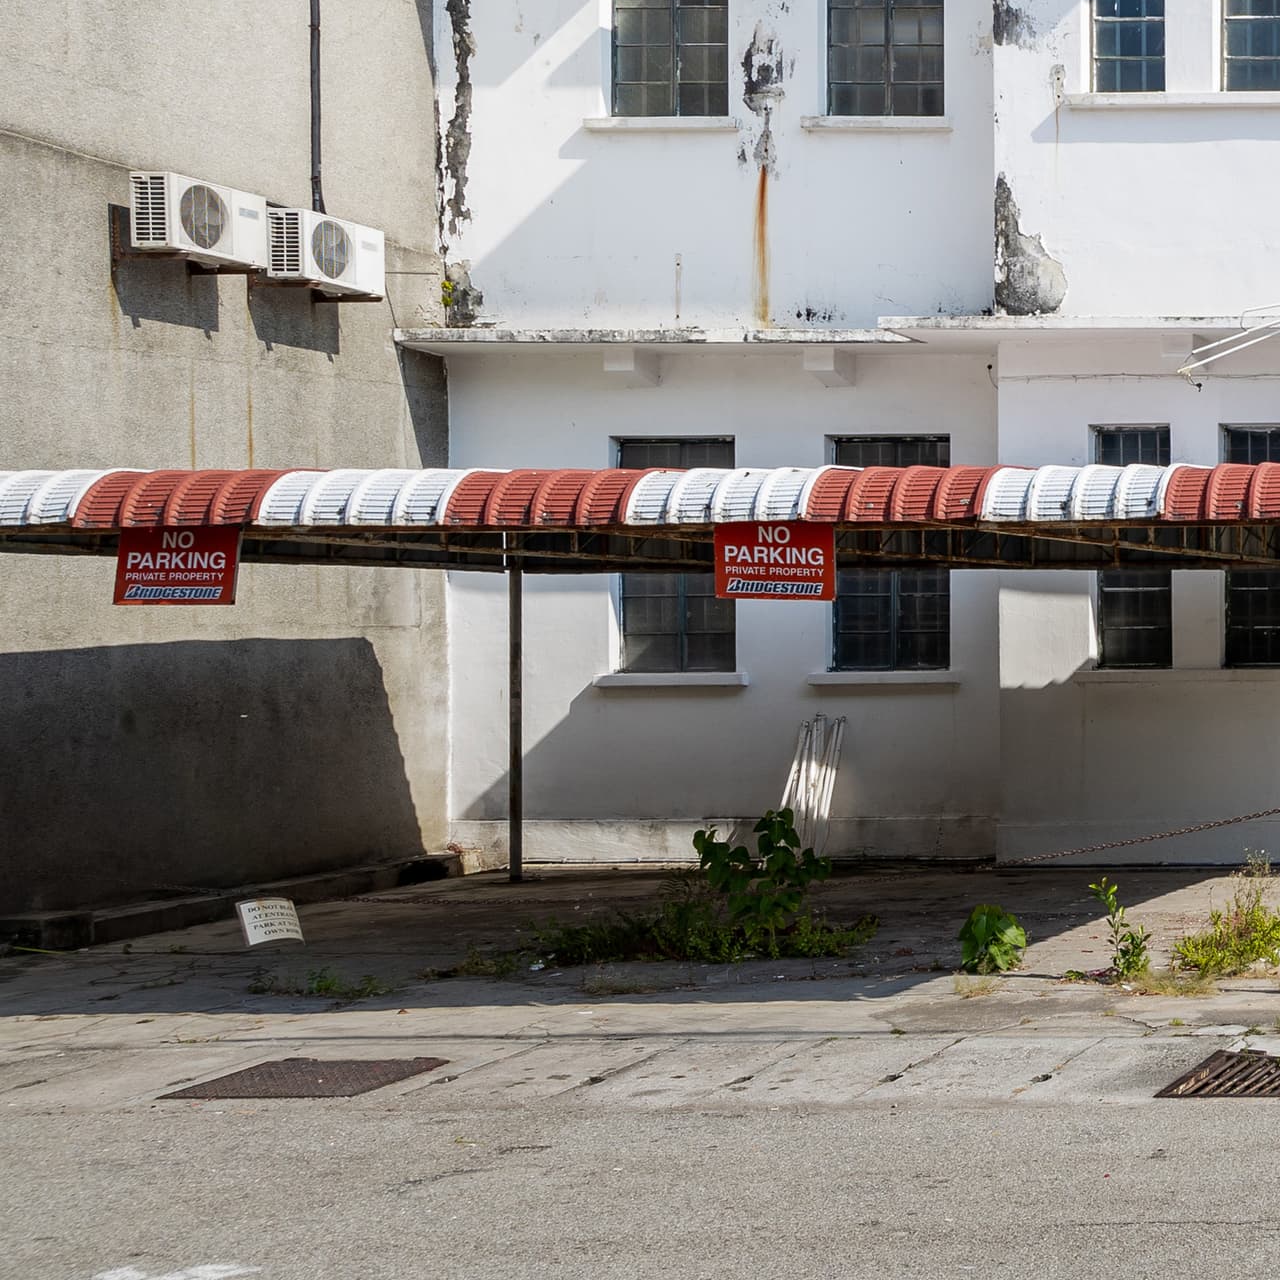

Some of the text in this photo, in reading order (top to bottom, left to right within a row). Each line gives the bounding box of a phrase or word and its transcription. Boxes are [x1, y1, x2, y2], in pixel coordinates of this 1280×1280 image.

[162, 531, 195, 549] NO
[758, 526, 791, 544] NO
[126, 551, 226, 570] PARKING
[724, 545, 824, 566] PARKING
[125, 572, 224, 581] PRIVATE PROPERTY
[725, 566, 824, 577] PRIVATE PROPERTY
[124, 584, 223, 600] BRIDGESTONE
[726, 577, 824, 595] BRIDGESTONE
[253, 922, 276, 930] PARK
